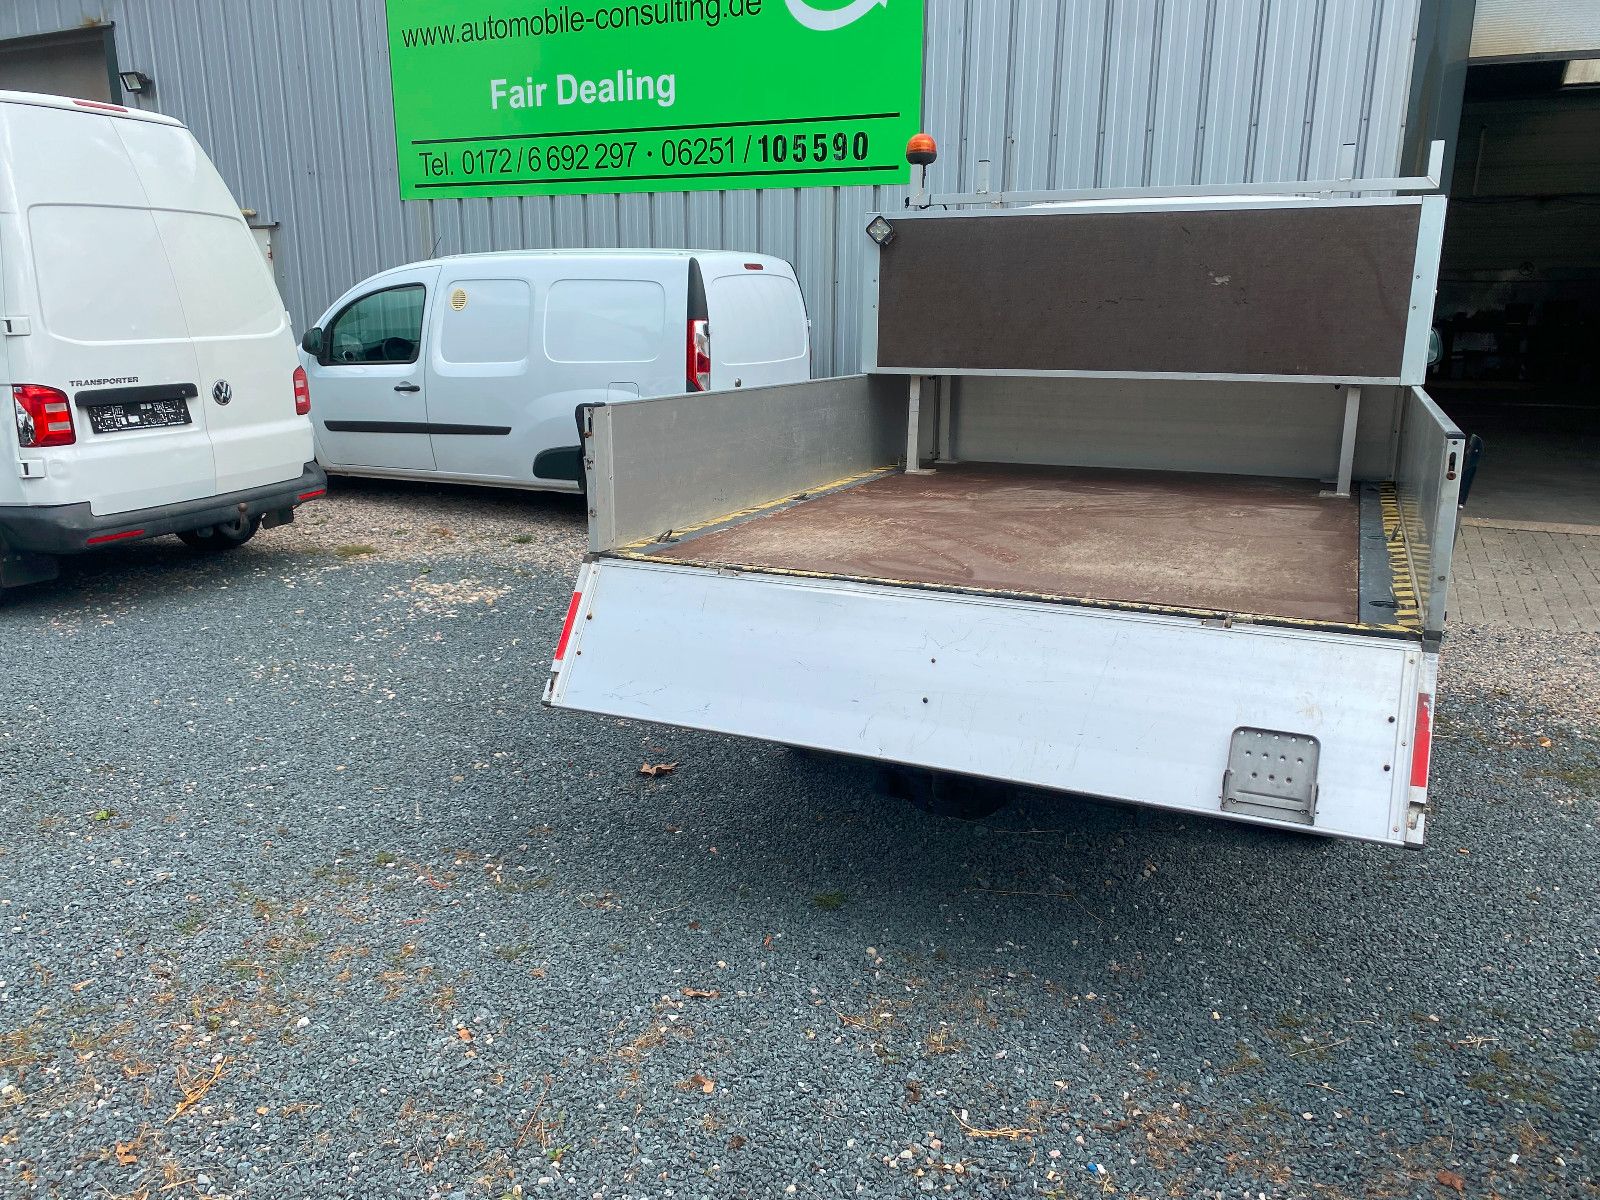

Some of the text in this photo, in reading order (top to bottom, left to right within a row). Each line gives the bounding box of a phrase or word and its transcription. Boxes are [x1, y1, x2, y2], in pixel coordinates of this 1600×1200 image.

[401, 0, 763, 48] www.automobile-consulting.de
[490, 69, 676, 110] Fair Dealing
[418, 151, 454, 176] Tel.
[68, 376, 139, 388] TRANSPORTER
